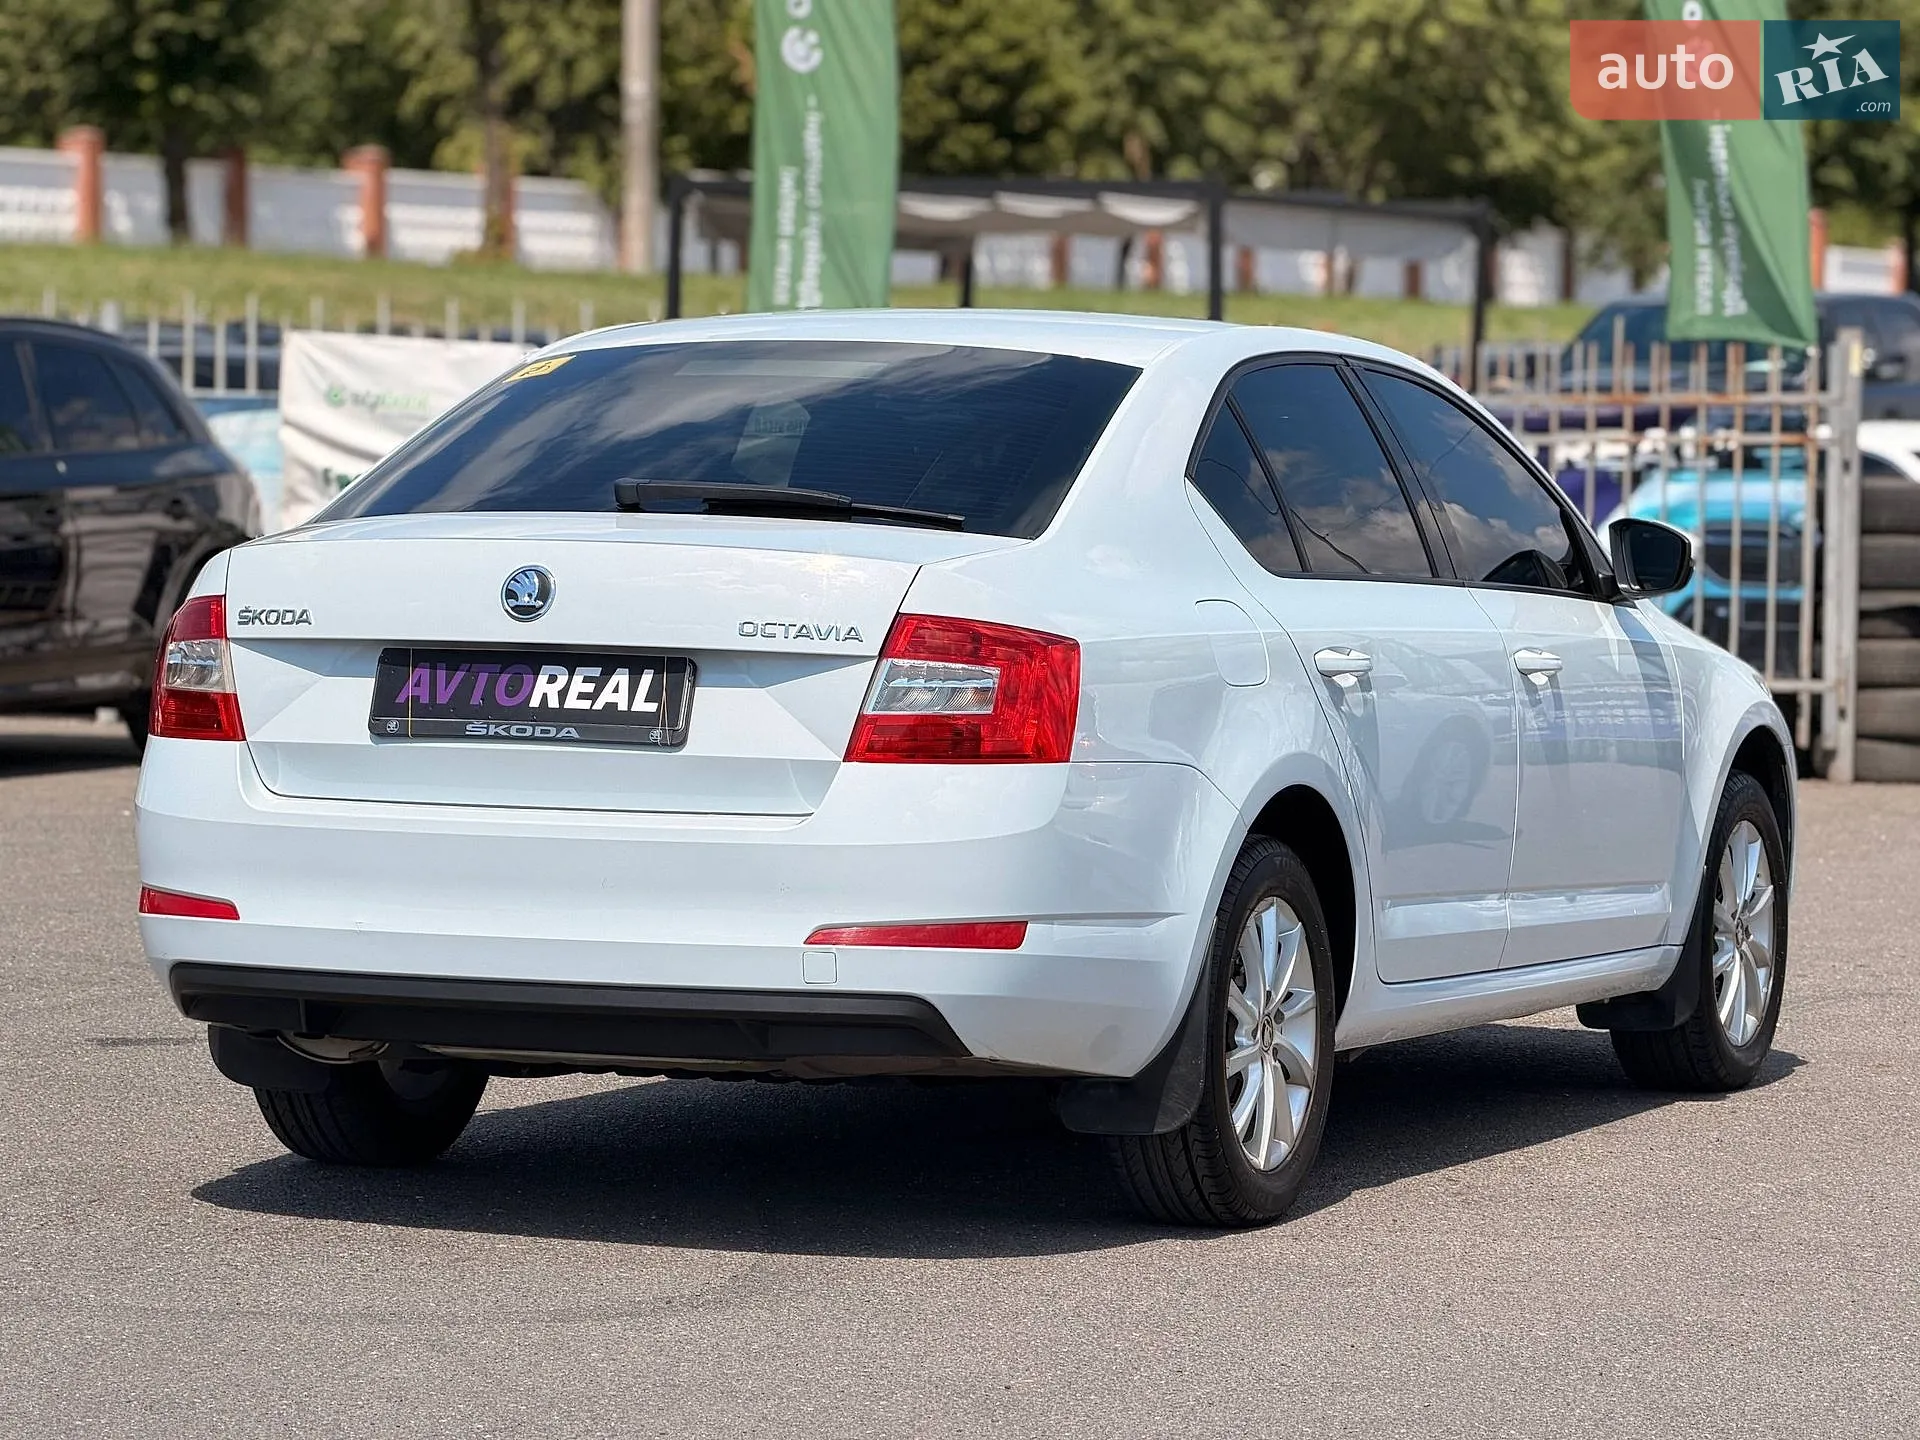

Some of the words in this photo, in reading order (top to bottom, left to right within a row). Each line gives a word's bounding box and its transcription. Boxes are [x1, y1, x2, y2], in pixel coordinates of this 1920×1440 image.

[237, 605, 312, 626] ŠKODA
[738, 620, 864, 642] OCTAVIA
[395, 662, 659, 712] AVTOREAL
[465, 721, 580, 739] ŠKODA
